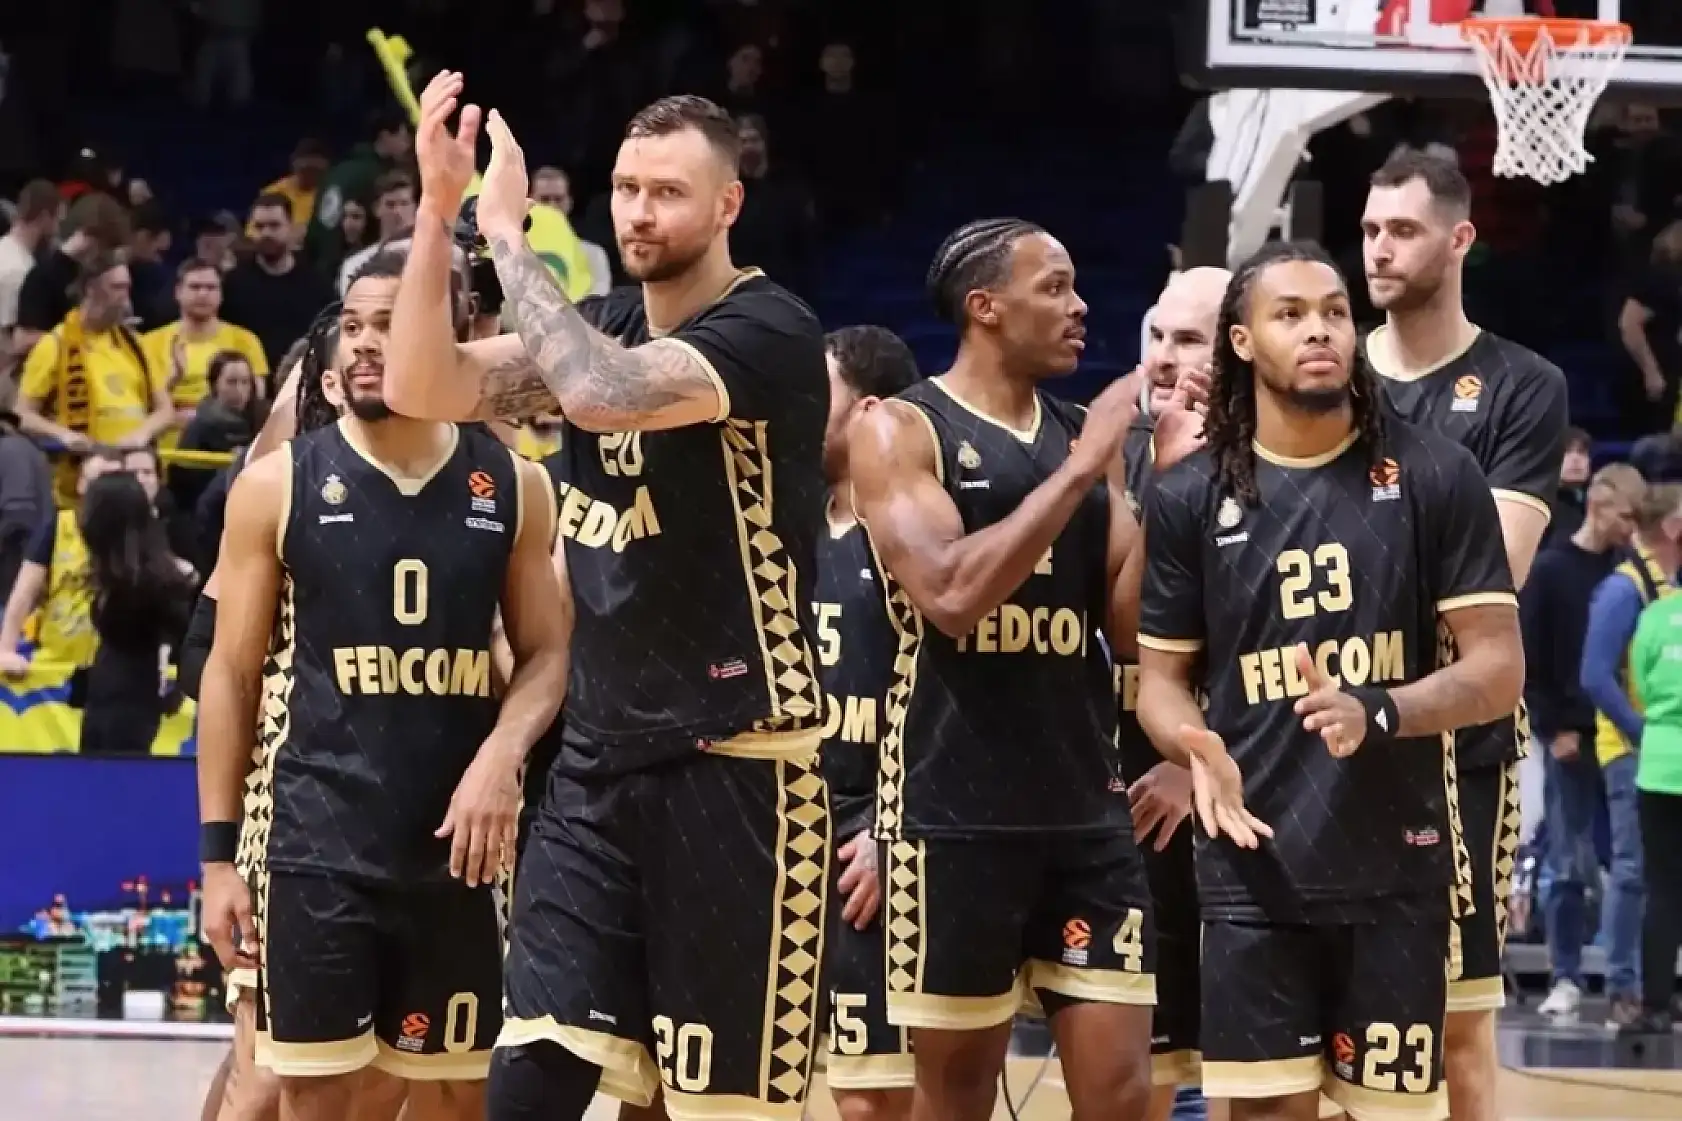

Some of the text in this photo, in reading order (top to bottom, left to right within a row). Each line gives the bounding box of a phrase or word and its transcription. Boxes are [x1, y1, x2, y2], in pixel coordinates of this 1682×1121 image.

[393, 558, 429, 626] 0
[1276, 542, 1353, 620] 23
[811, 602, 842, 666] 5
[957, 603, 1087, 658] EDCO
[333, 644, 490, 697] FEDCOM
[1113, 908, 1143, 972] 4
[443, 991, 479, 1053] 0
[652, 1014, 714, 1092] 20
[829, 989, 869, 1055] 5
[1363, 1022, 1433, 1094] 23
